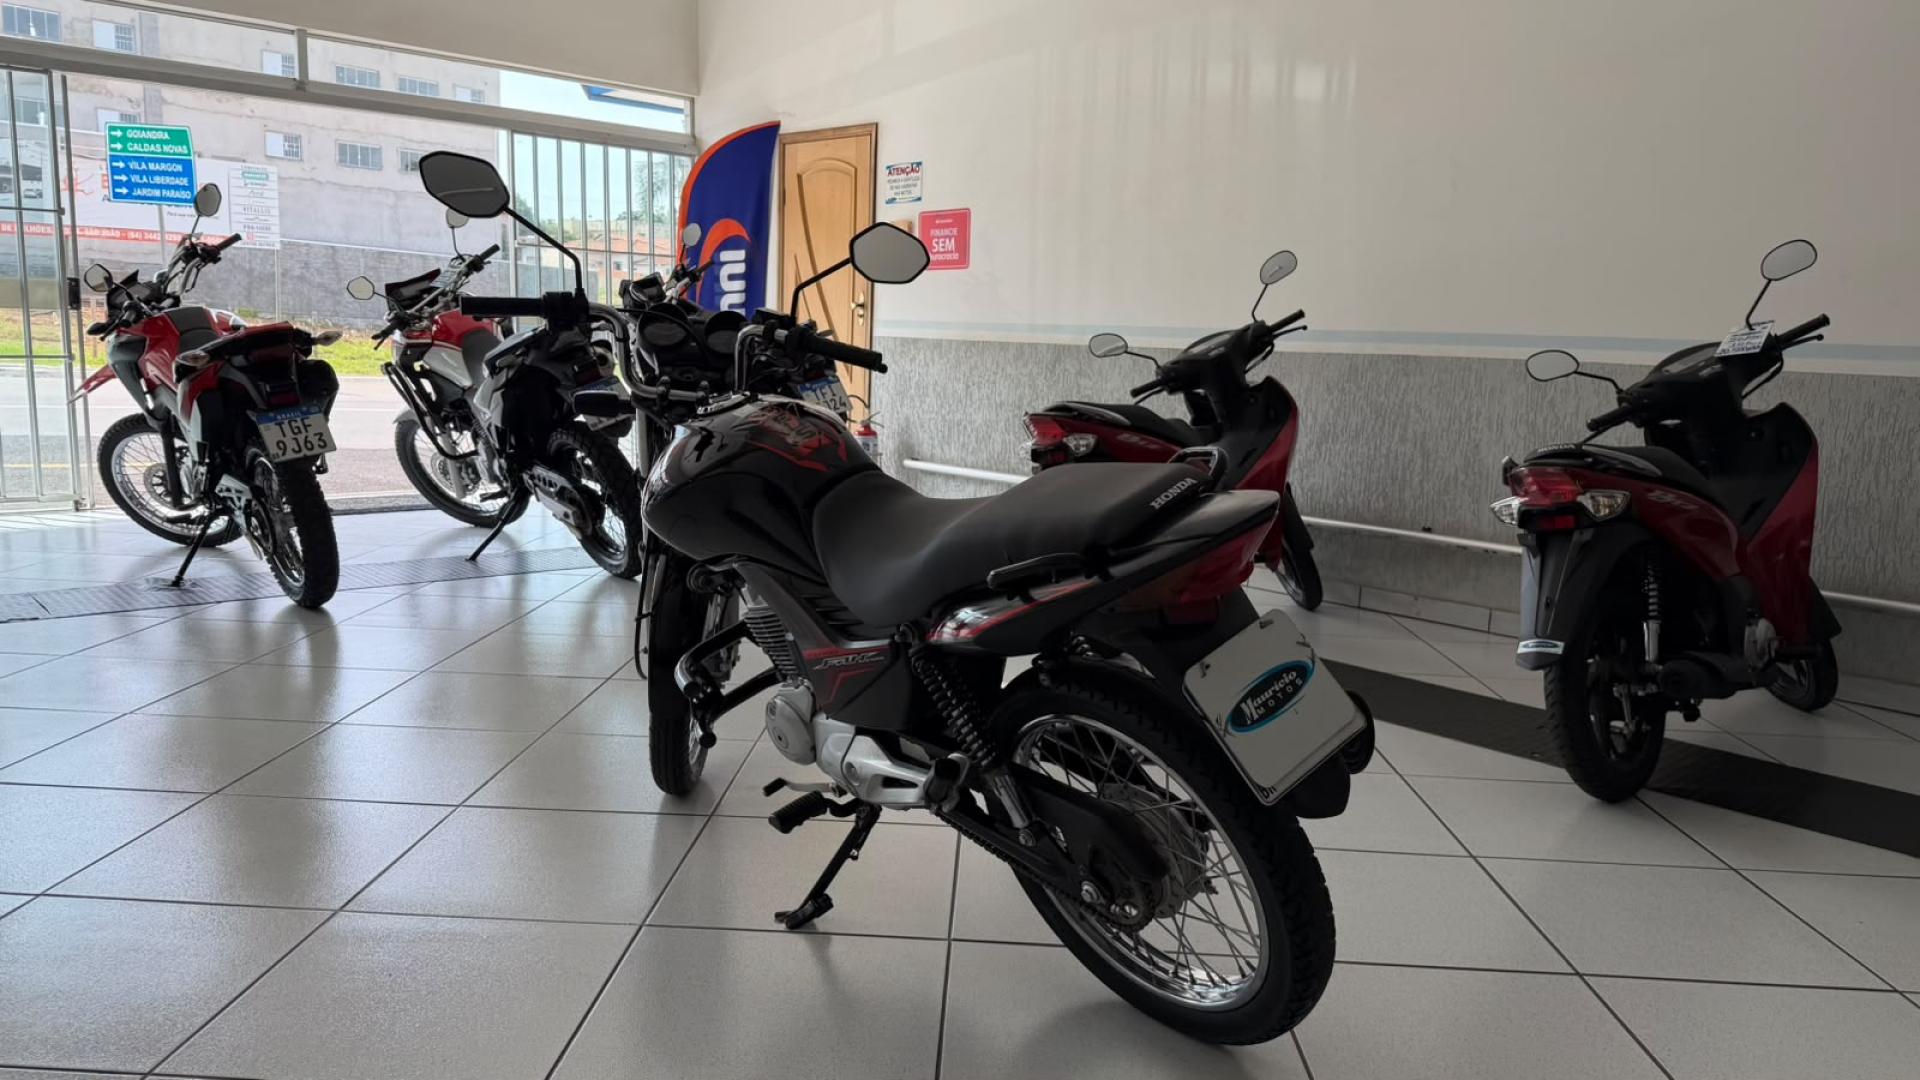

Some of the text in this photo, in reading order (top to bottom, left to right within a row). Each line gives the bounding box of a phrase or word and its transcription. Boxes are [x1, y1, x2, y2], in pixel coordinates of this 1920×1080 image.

[126, 142, 189, 154] CALDAS NOVAS
[127, 160, 148, 170] VILA
[887, 163, 921, 177] ATENÇÃO
[129, 174, 189, 186] VILA LIBERDADE
[132, 187, 161, 198] JARDIM
[931, 236, 956, 253] SEM
[274, 416, 313, 438] TGF
[275, 431, 328, 457] 9J63
[1149, 477, 1199, 510] HONDA
[1257, 677, 1304, 715] MOTOS
